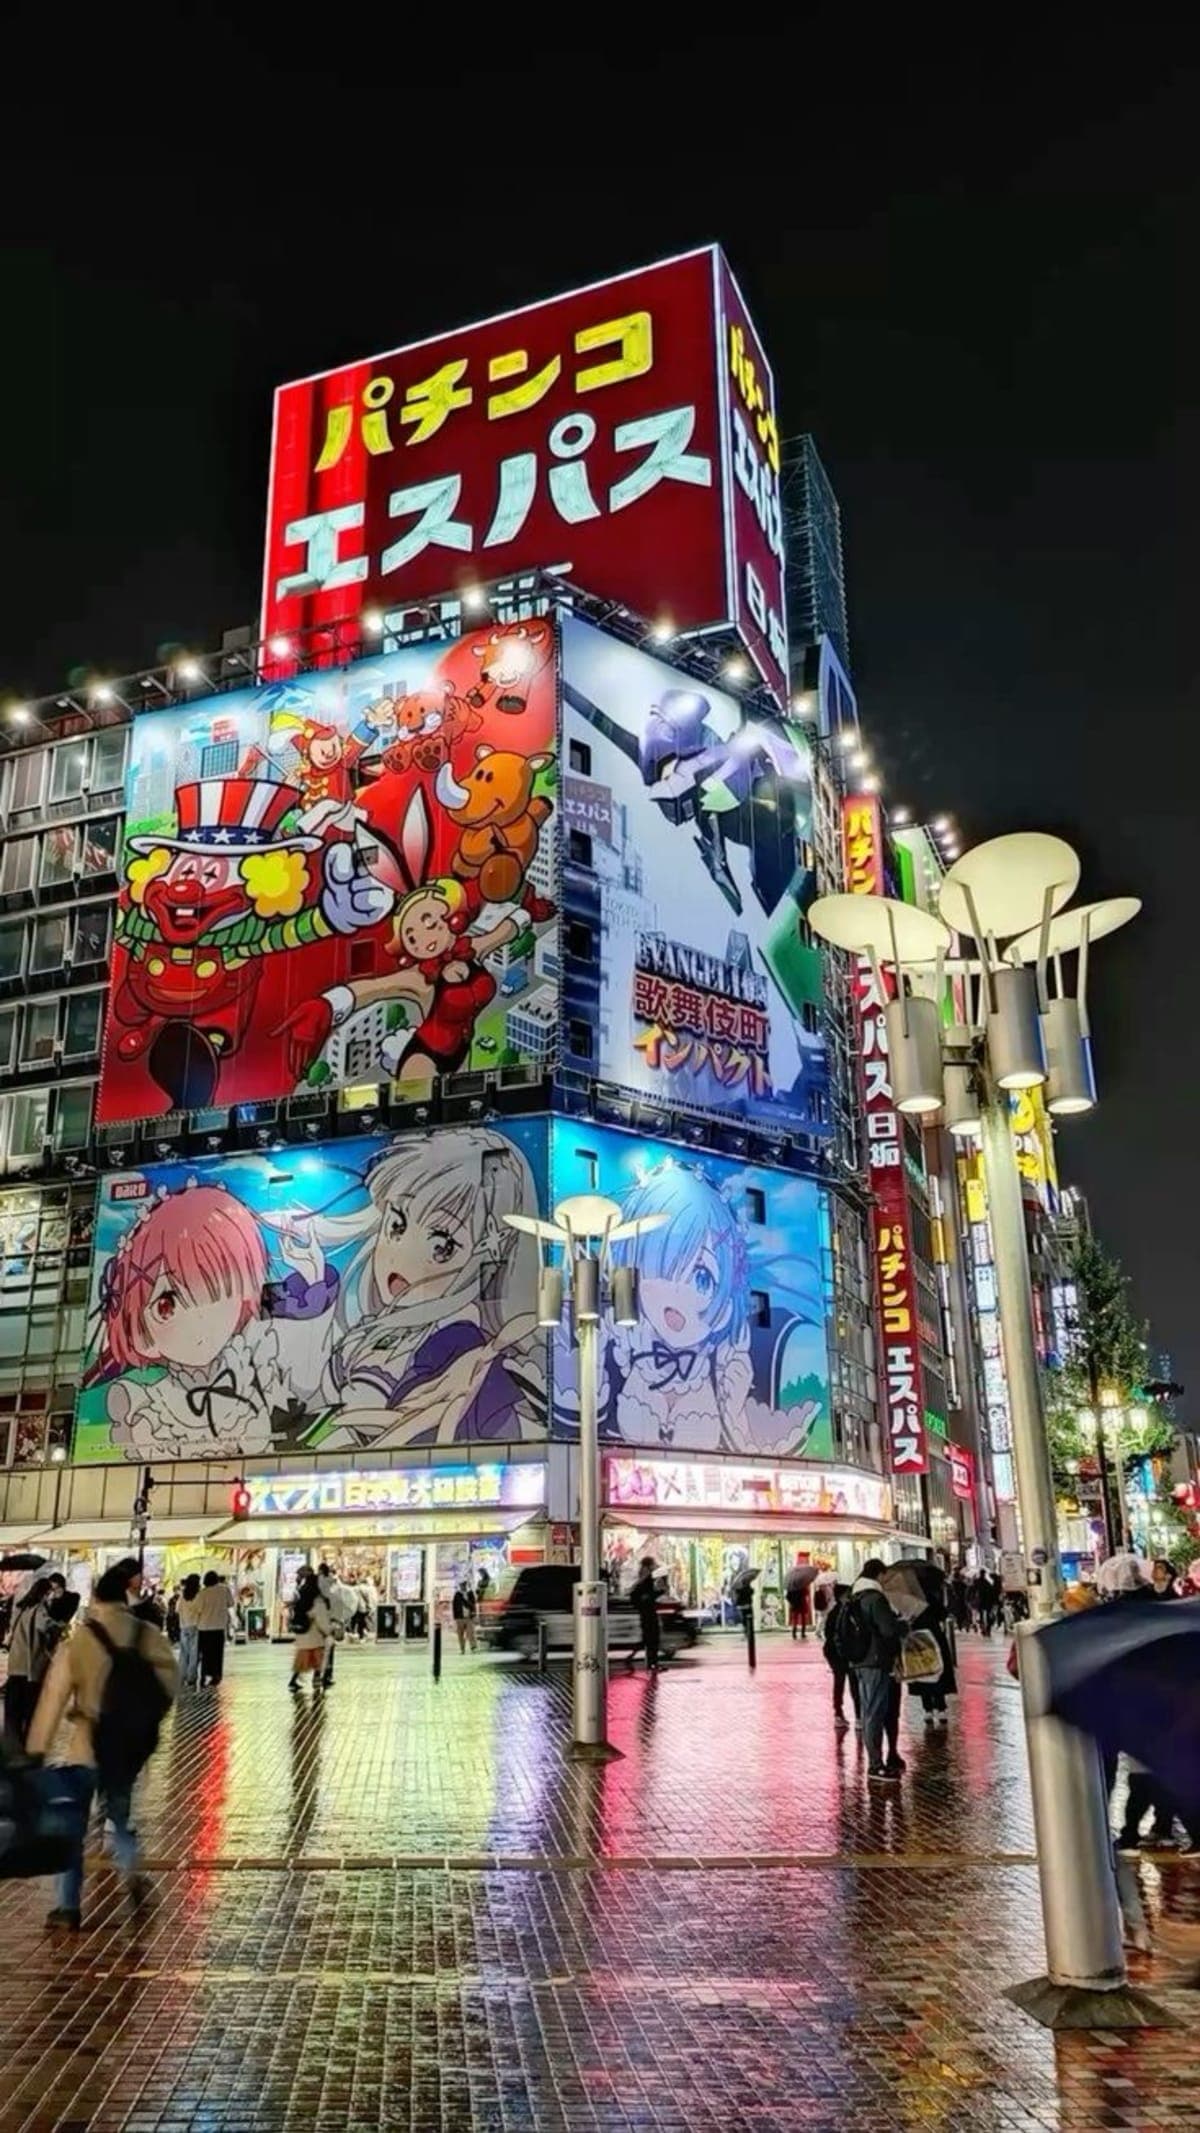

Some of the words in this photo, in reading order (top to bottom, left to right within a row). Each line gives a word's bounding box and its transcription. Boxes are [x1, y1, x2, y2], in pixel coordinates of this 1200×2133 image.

[314, 311, 653, 474] パチンコ
[276, 404, 712, 601] エスパス
[564, 798, 612, 825] エスパス
[633, 1022, 773, 1097] インパクト
[634, 971, 769, 1052] 歌舞伎町
[878, 1225, 912, 1334] パチンコ
[887, 1346, 924, 1466] エスパス
